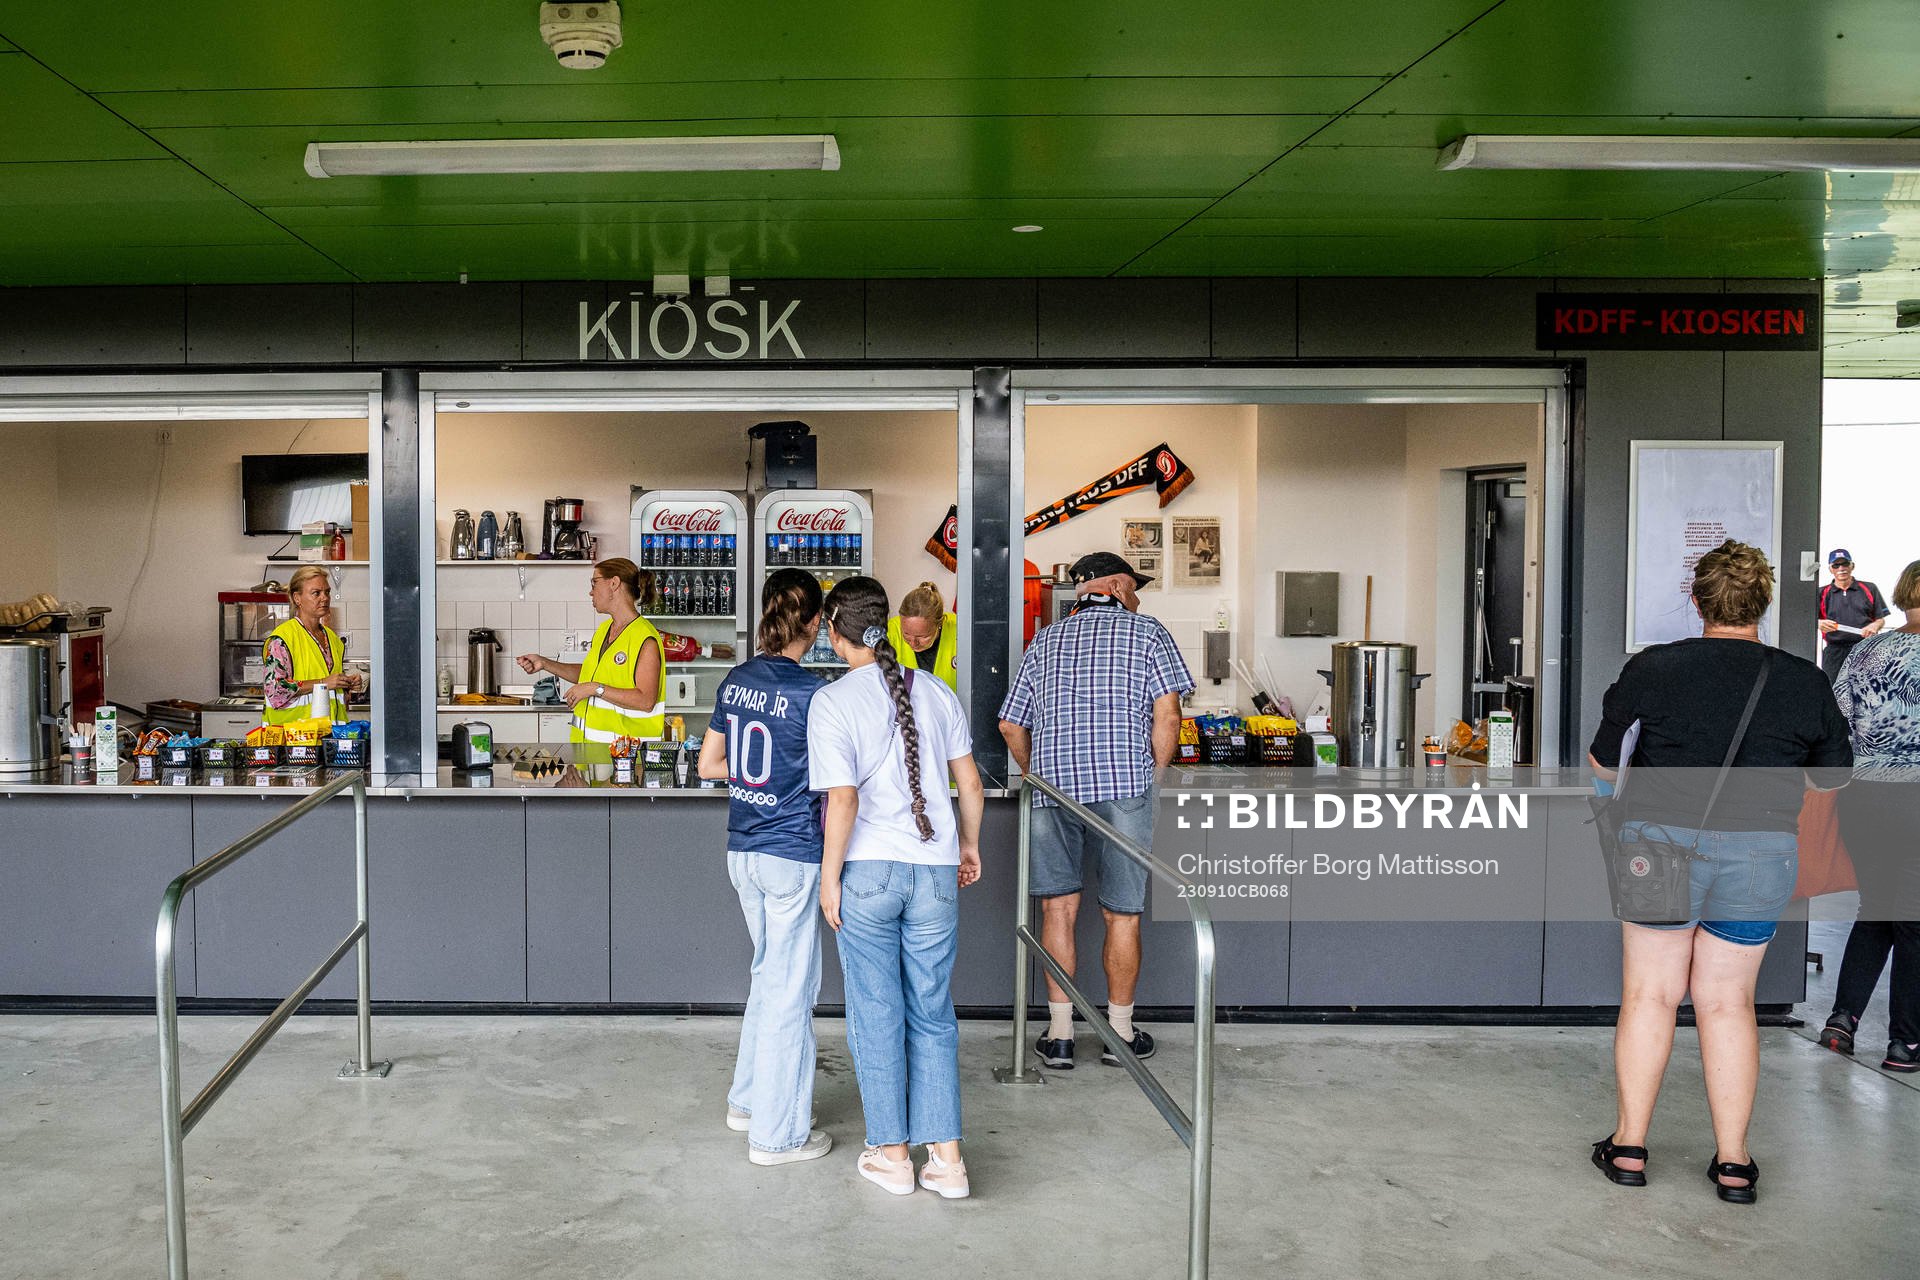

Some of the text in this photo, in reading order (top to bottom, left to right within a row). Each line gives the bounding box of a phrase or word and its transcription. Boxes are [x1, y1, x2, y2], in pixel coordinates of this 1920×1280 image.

[579, 299, 806, 360] KIOSK
[1554, 308, 1637, 334] KDFF
[1660, 309, 1805, 335] KIOSKEN
[652, 508, 725, 532] Coca-Cola
[777, 508, 850, 531] Coca-Cola
[726, 713, 772, 787] 10
